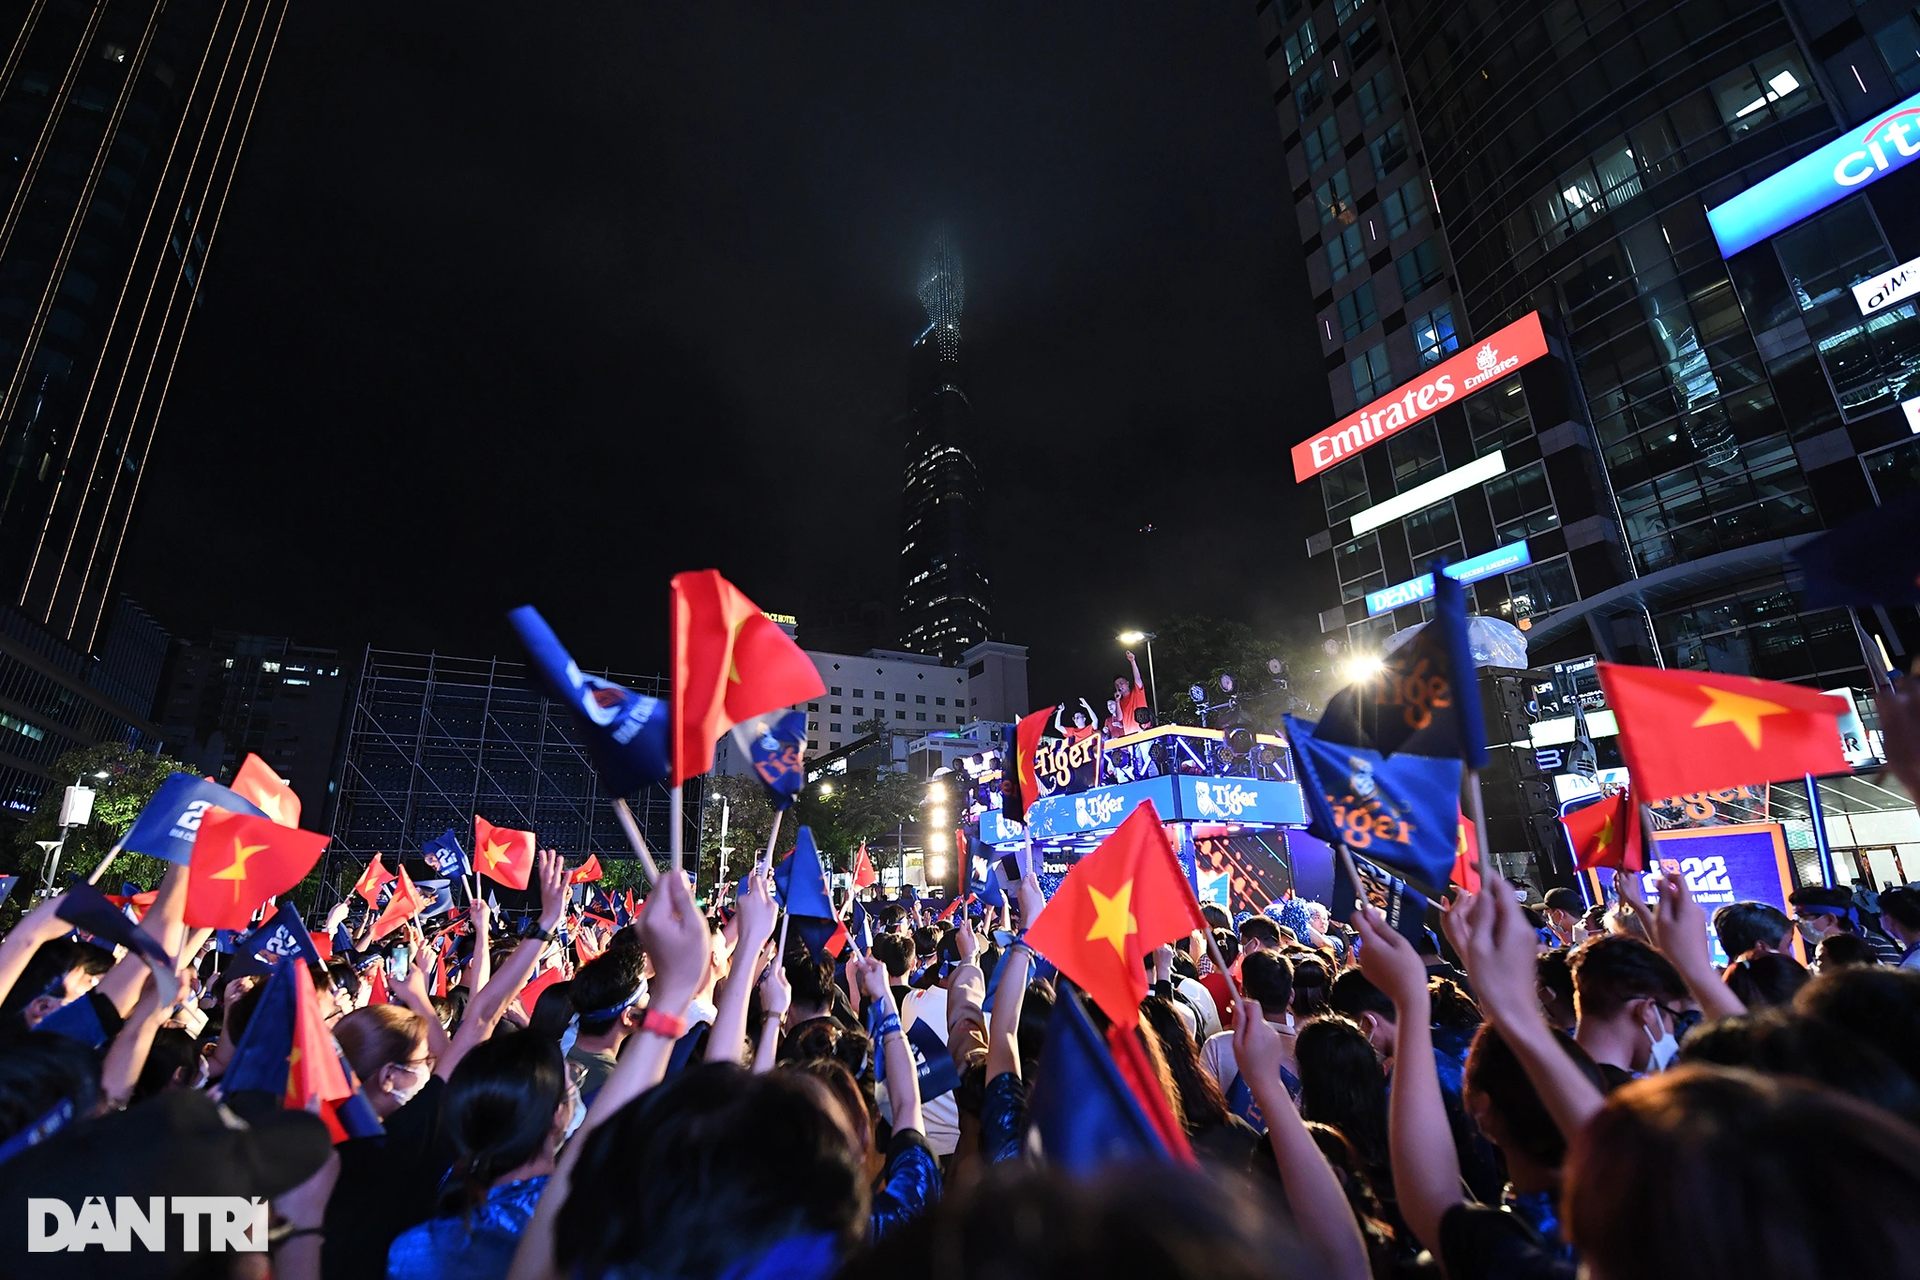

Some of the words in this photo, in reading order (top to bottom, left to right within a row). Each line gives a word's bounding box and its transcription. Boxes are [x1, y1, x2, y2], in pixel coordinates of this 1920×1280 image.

[1834, 117, 1920, 186] cit
[1464, 355, 1519, 390] Emirates
[1309, 374, 1455, 469] Emirates
[1460, 566, 1485, 579] ACCESS
[1485, 555, 1519, 571] AMERICA
[1373, 580, 1425, 612] DEAN
[1034, 736, 1093, 787] Tiger
[1087, 792, 1124, 823] Tiger
[1212, 783, 1258, 815] Tiger
